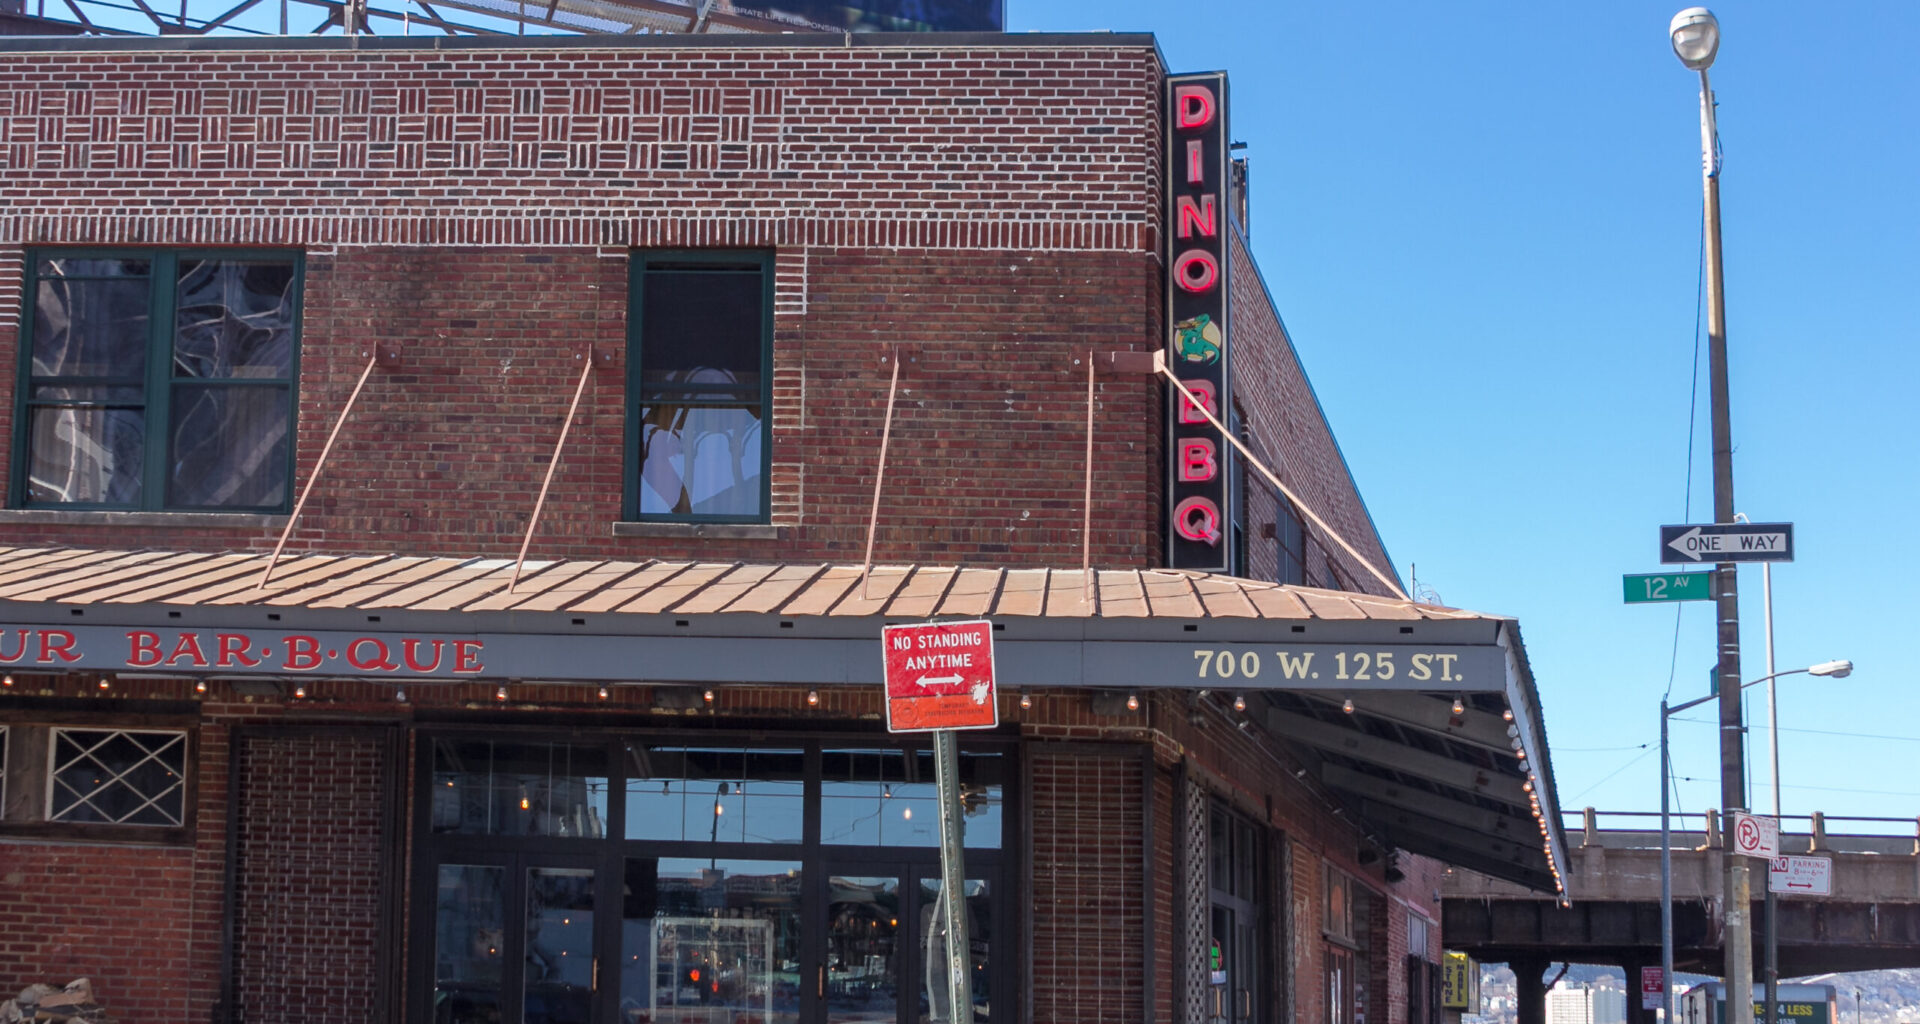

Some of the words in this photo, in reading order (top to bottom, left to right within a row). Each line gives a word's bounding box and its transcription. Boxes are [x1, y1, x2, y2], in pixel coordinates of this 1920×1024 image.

[765, 13, 786, 22] LIFE
[1173, 85, 1219, 293] DINO
[1173, 379, 1222, 548] BBQ
[1686, 536, 1721, 551] ONE
[1740, 535, 1778, 550] WAY
[1644, 577, 1668, 599] 12
[1673, 576, 1690, 588] AV
[894, 636, 912, 650] NO
[918, 632, 982, 649] STANDING
[905, 653, 973, 670] ANYTIME
[1194, 650, 1260, 678] 700
[1277, 652, 1319, 679] W.
[1335, 652, 1395, 680] 125
[1408, 653, 1463, 681] ST.
[1772, 857, 1788, 871] NO
[1793, 860, 1825, 869] PARKING
[1787, 1004, 1813, 1016] LESS
